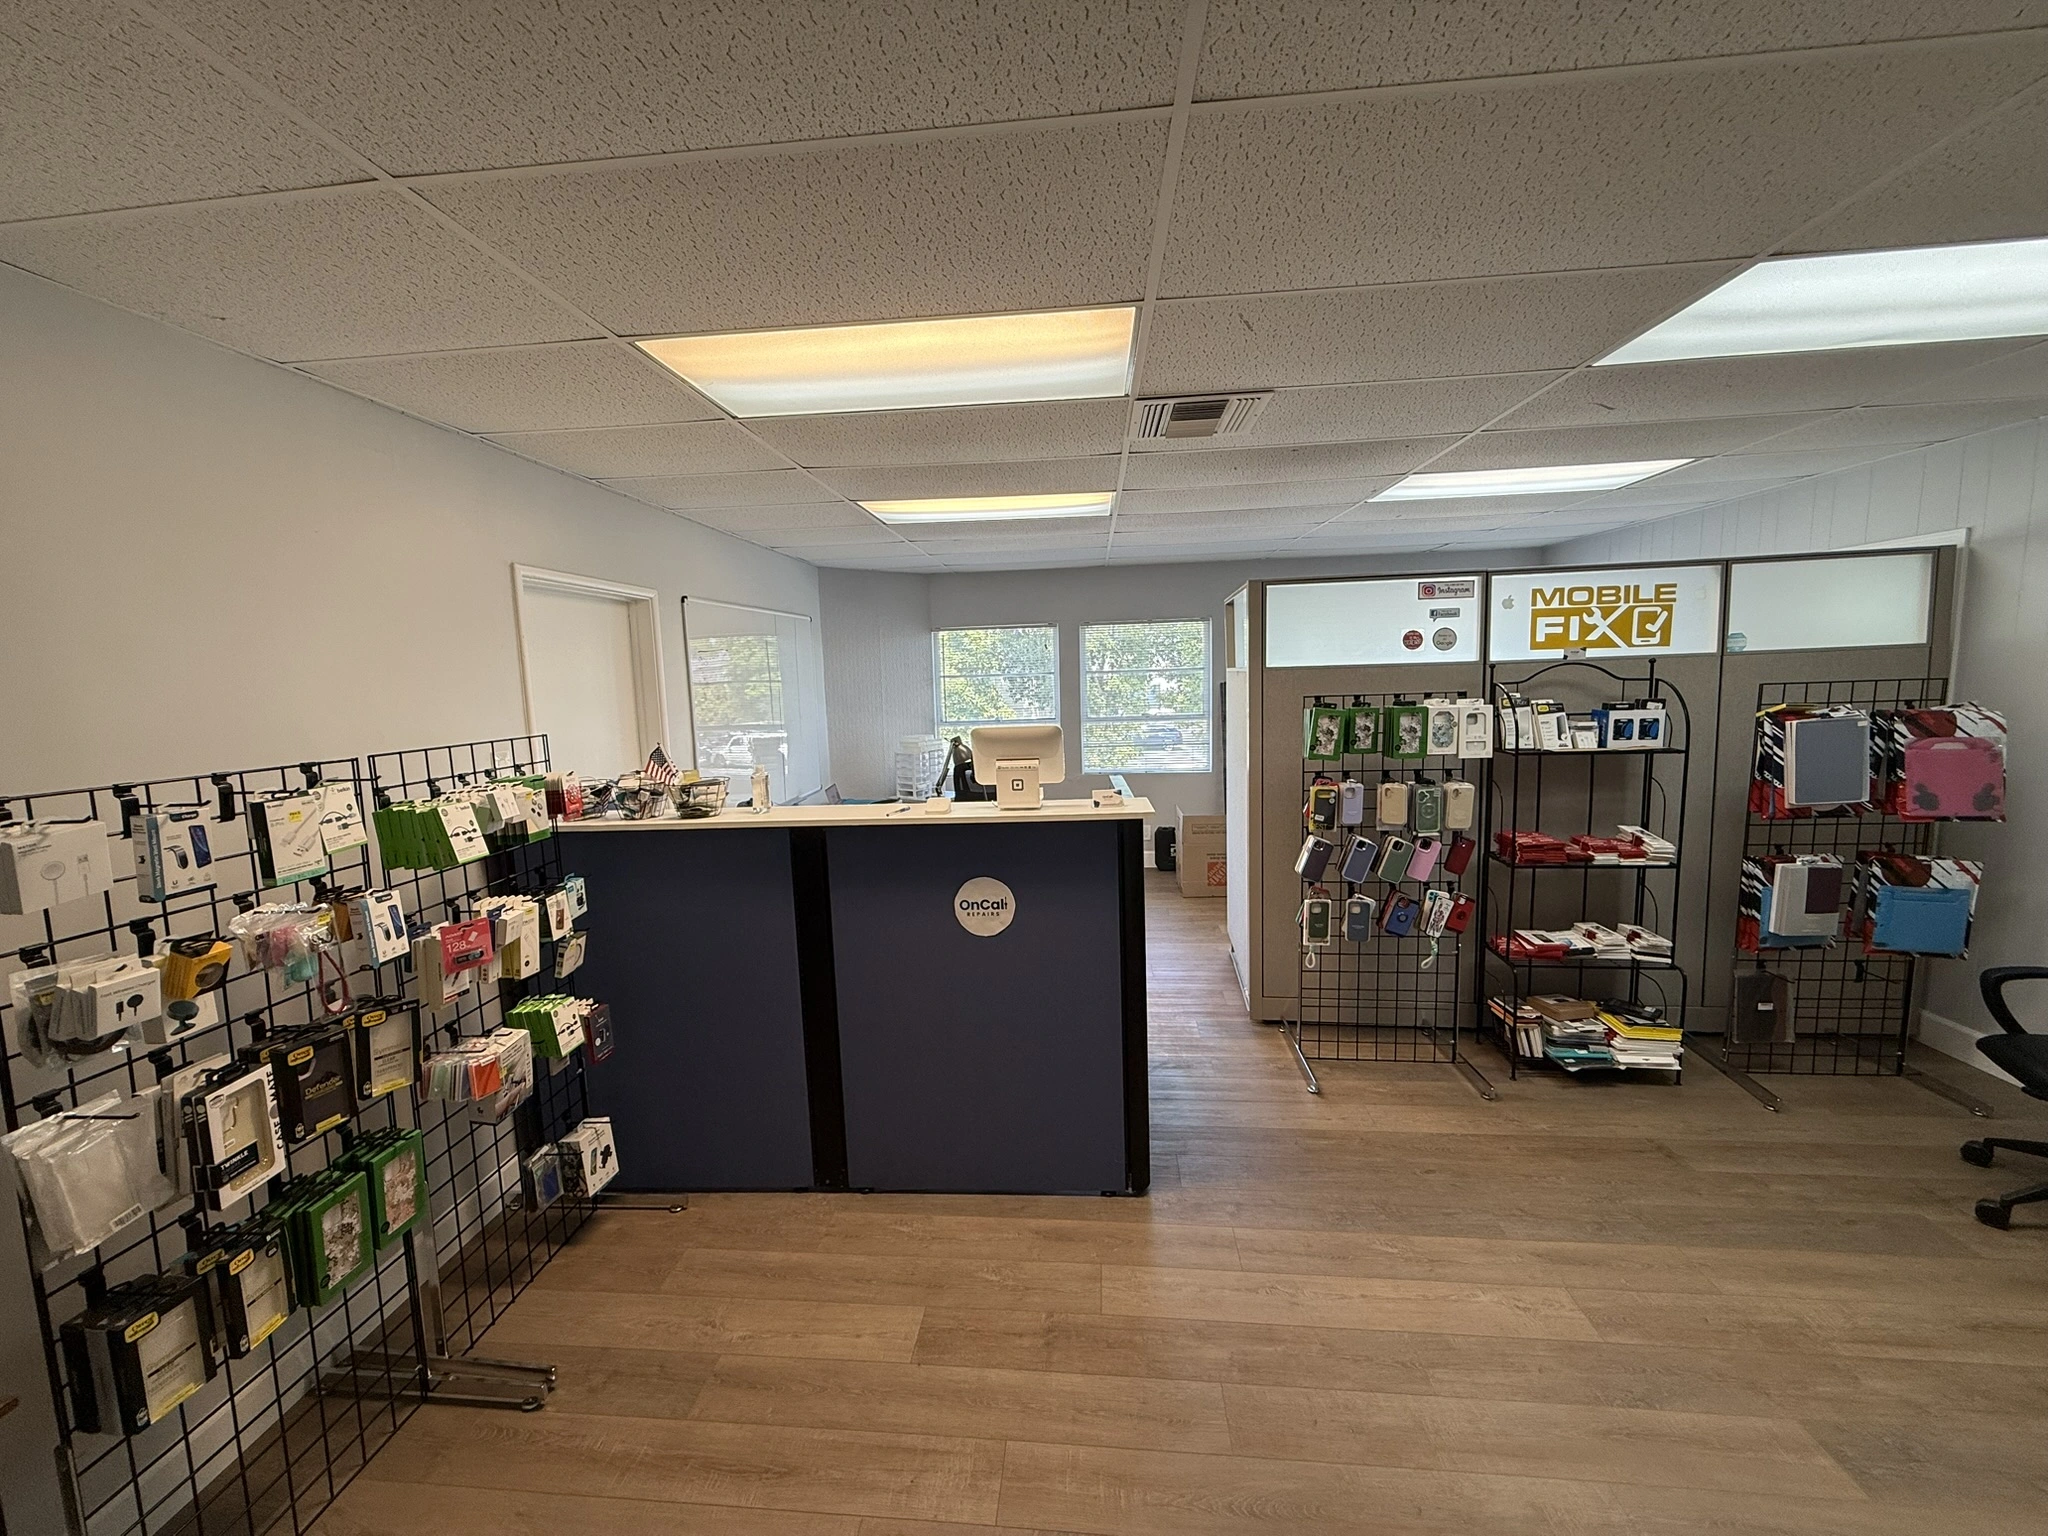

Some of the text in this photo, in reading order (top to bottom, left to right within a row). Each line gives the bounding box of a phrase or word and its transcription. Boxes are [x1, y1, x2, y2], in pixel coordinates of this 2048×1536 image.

[1531, 583, 1677, 607] MOBILE
[1535, 605, 1629, 648] FIX
[446, 940, 467, 953] 128
[304, 1075, 342, 1096] Defender
[266, 1070, 286, 1150] CASE MATE
[220, 1150, 249, 1170] TWINKLE
